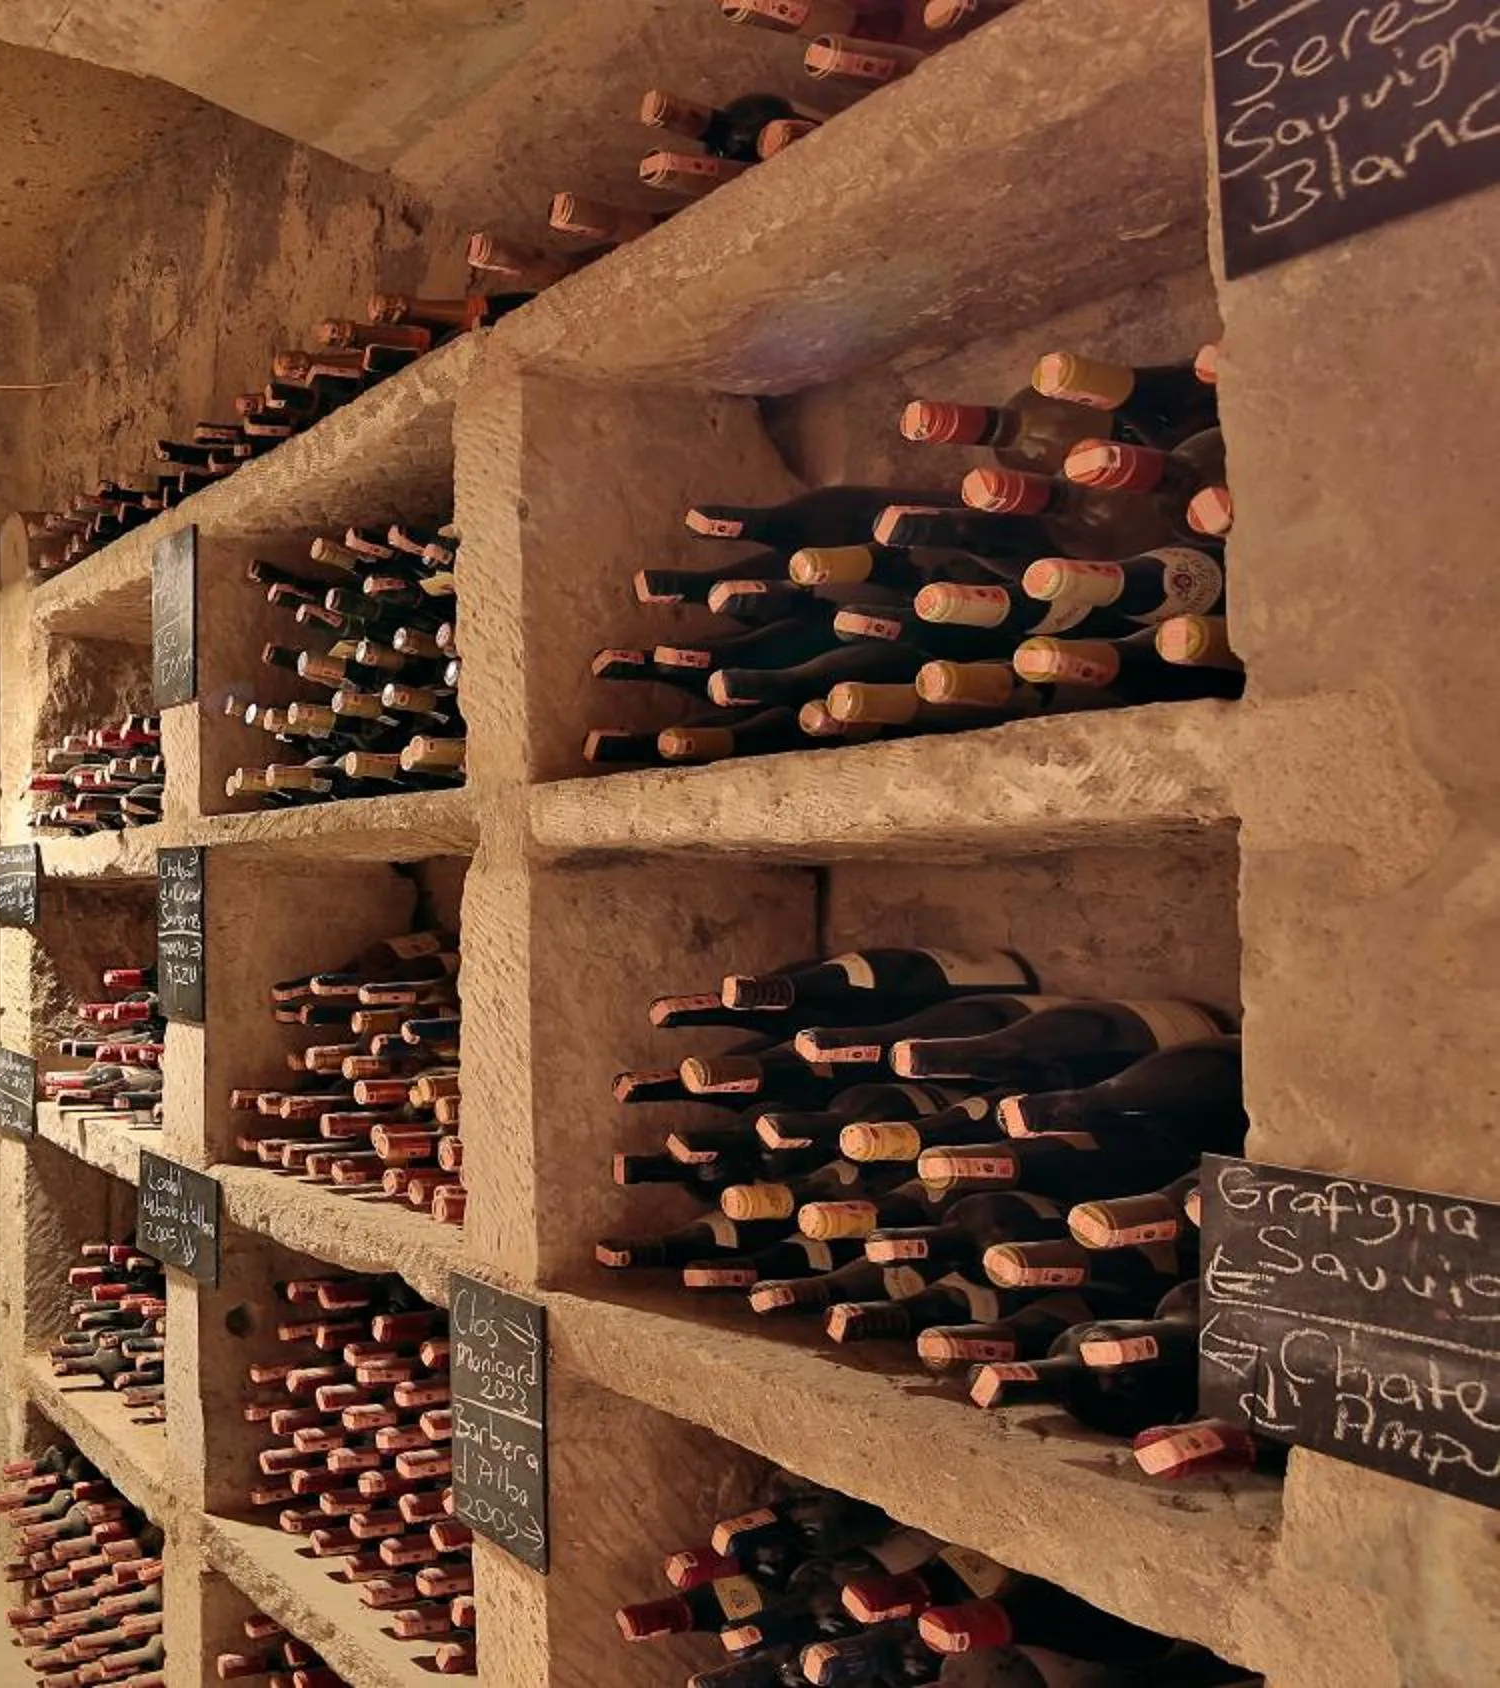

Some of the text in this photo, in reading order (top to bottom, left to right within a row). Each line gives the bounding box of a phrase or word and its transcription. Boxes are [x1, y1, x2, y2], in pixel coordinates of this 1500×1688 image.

[1217, 1165, 1480, 1247] Grafigna
[452, 1288, 499, 1349] Clos
[479, 1374, 529, 1416] 2003
[453, 1402, 540, 1477] Barbera
[456, 1490, 520, 1540] 2005
